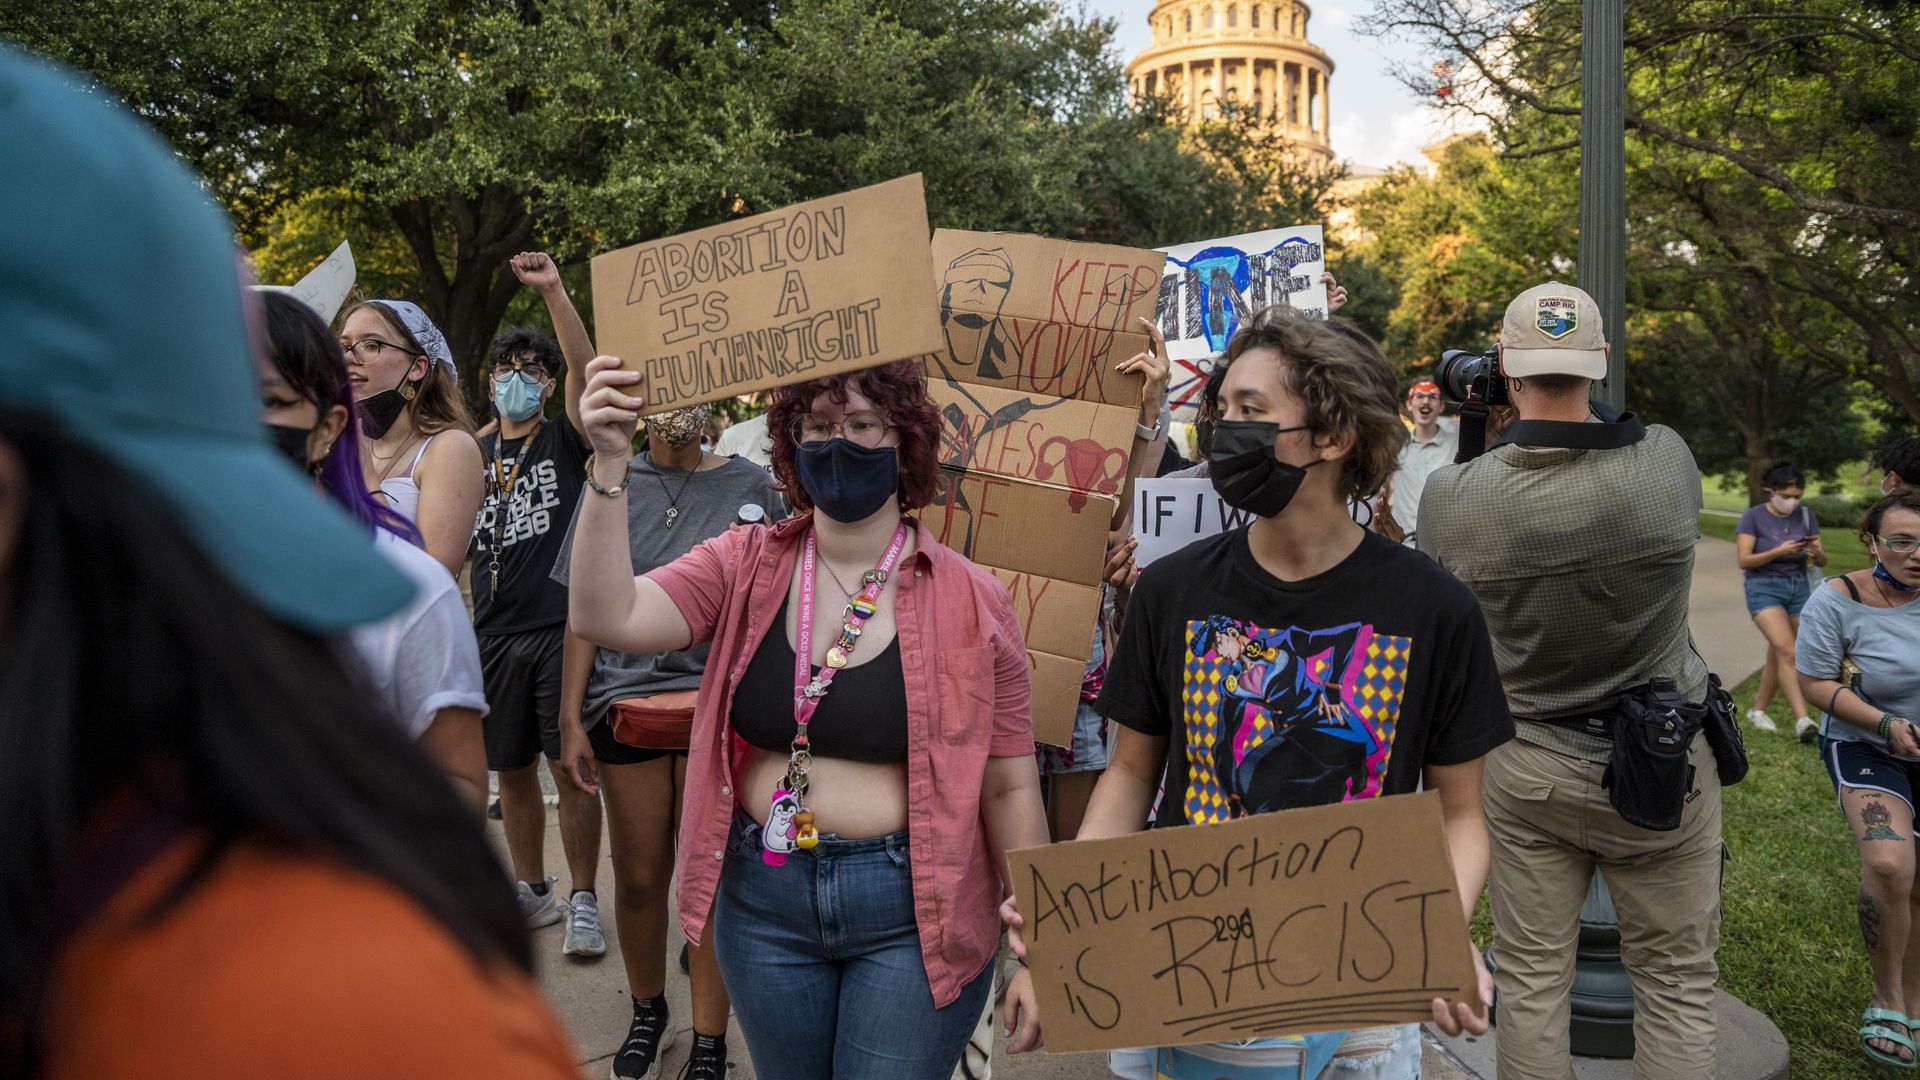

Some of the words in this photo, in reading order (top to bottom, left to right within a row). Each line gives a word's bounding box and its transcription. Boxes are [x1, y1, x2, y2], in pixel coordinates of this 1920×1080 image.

[626, 206, 846, 305] ABORTION
[659, 291, 730, 345] IS
[774, 269, 810, 318] A
[1049, 258, 1158, 333] KEEP
[1562, 302, 1576, 310] RIO
[1012, 318, 1114, 404] YOUR
[1142, 490, 1177, 537] IF
[1194, 493, 1204, 534] I
[880, 544, 899, 573] MARRIE
[801, 631, 809, 652] GOLD
[1151, 880, 1453, 1010] RACIST
[1213, 913, 1254, 943] 296
